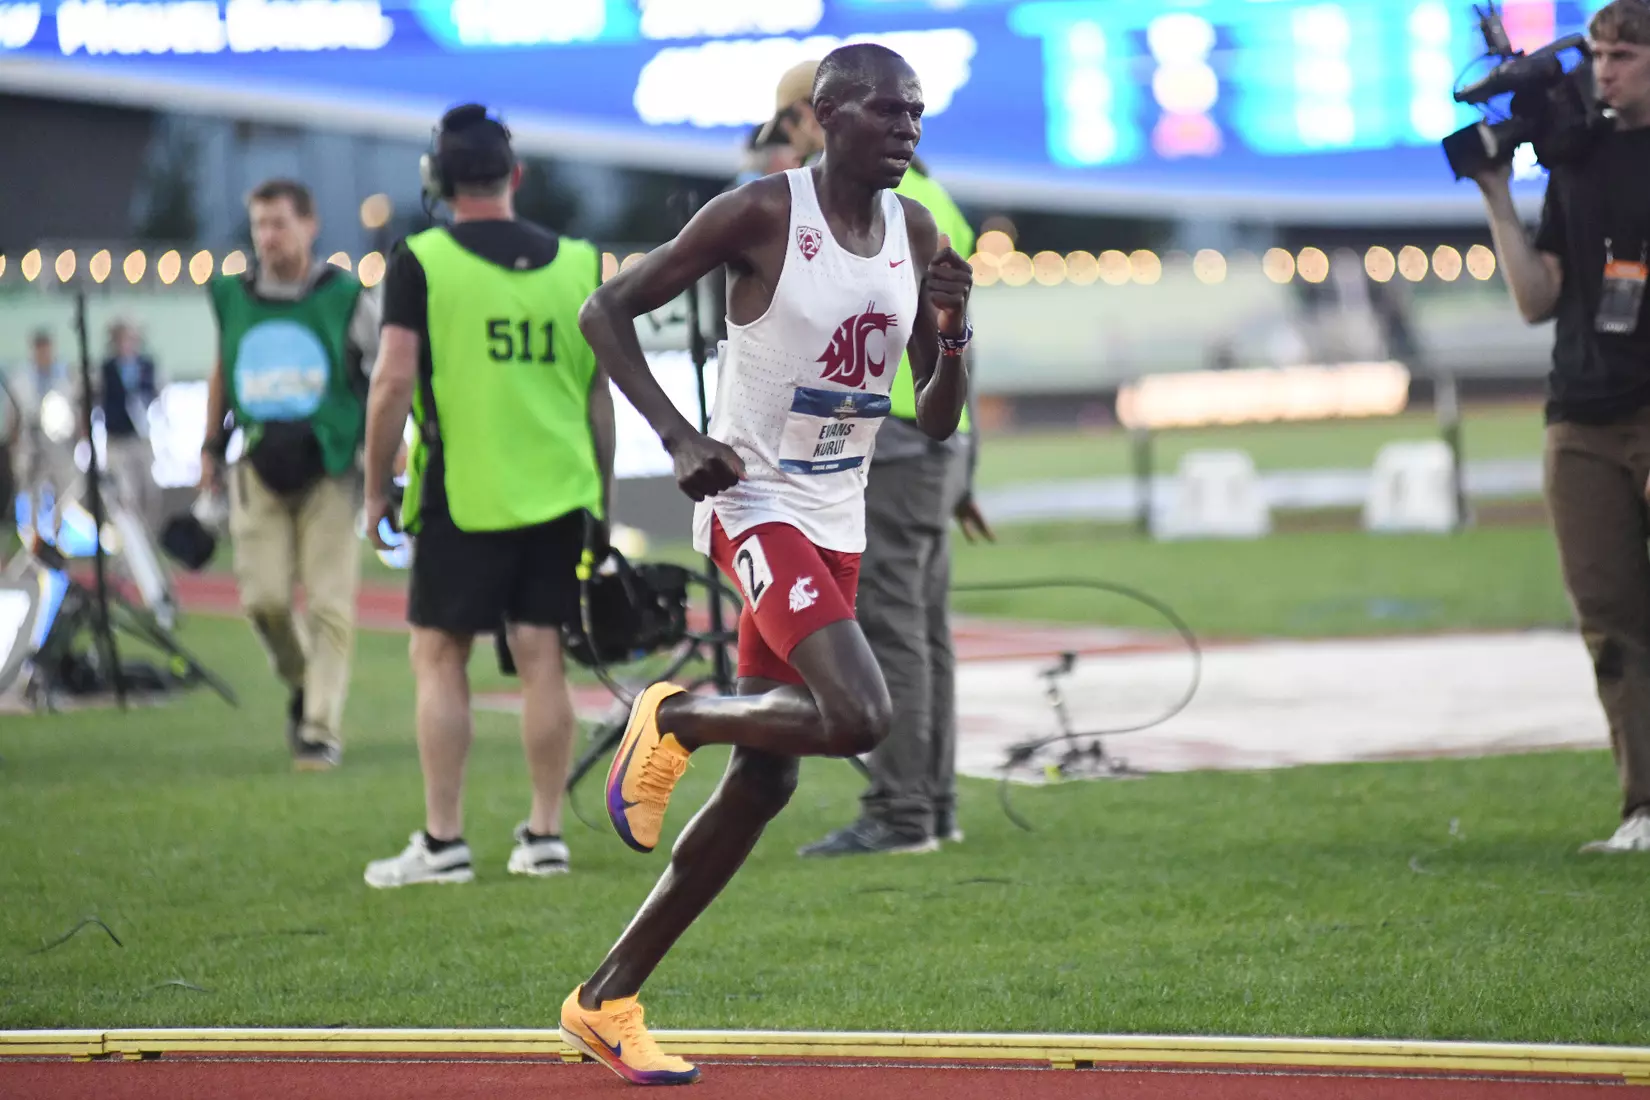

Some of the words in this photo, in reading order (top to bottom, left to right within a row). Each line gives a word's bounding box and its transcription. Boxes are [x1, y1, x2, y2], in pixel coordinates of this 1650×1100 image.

[487, 318, 556, 363] 511
[819, 423, 855, 439] EVANS
[813, 440, 845, 457] KURUI
[737, 549, 765, 603] 2
